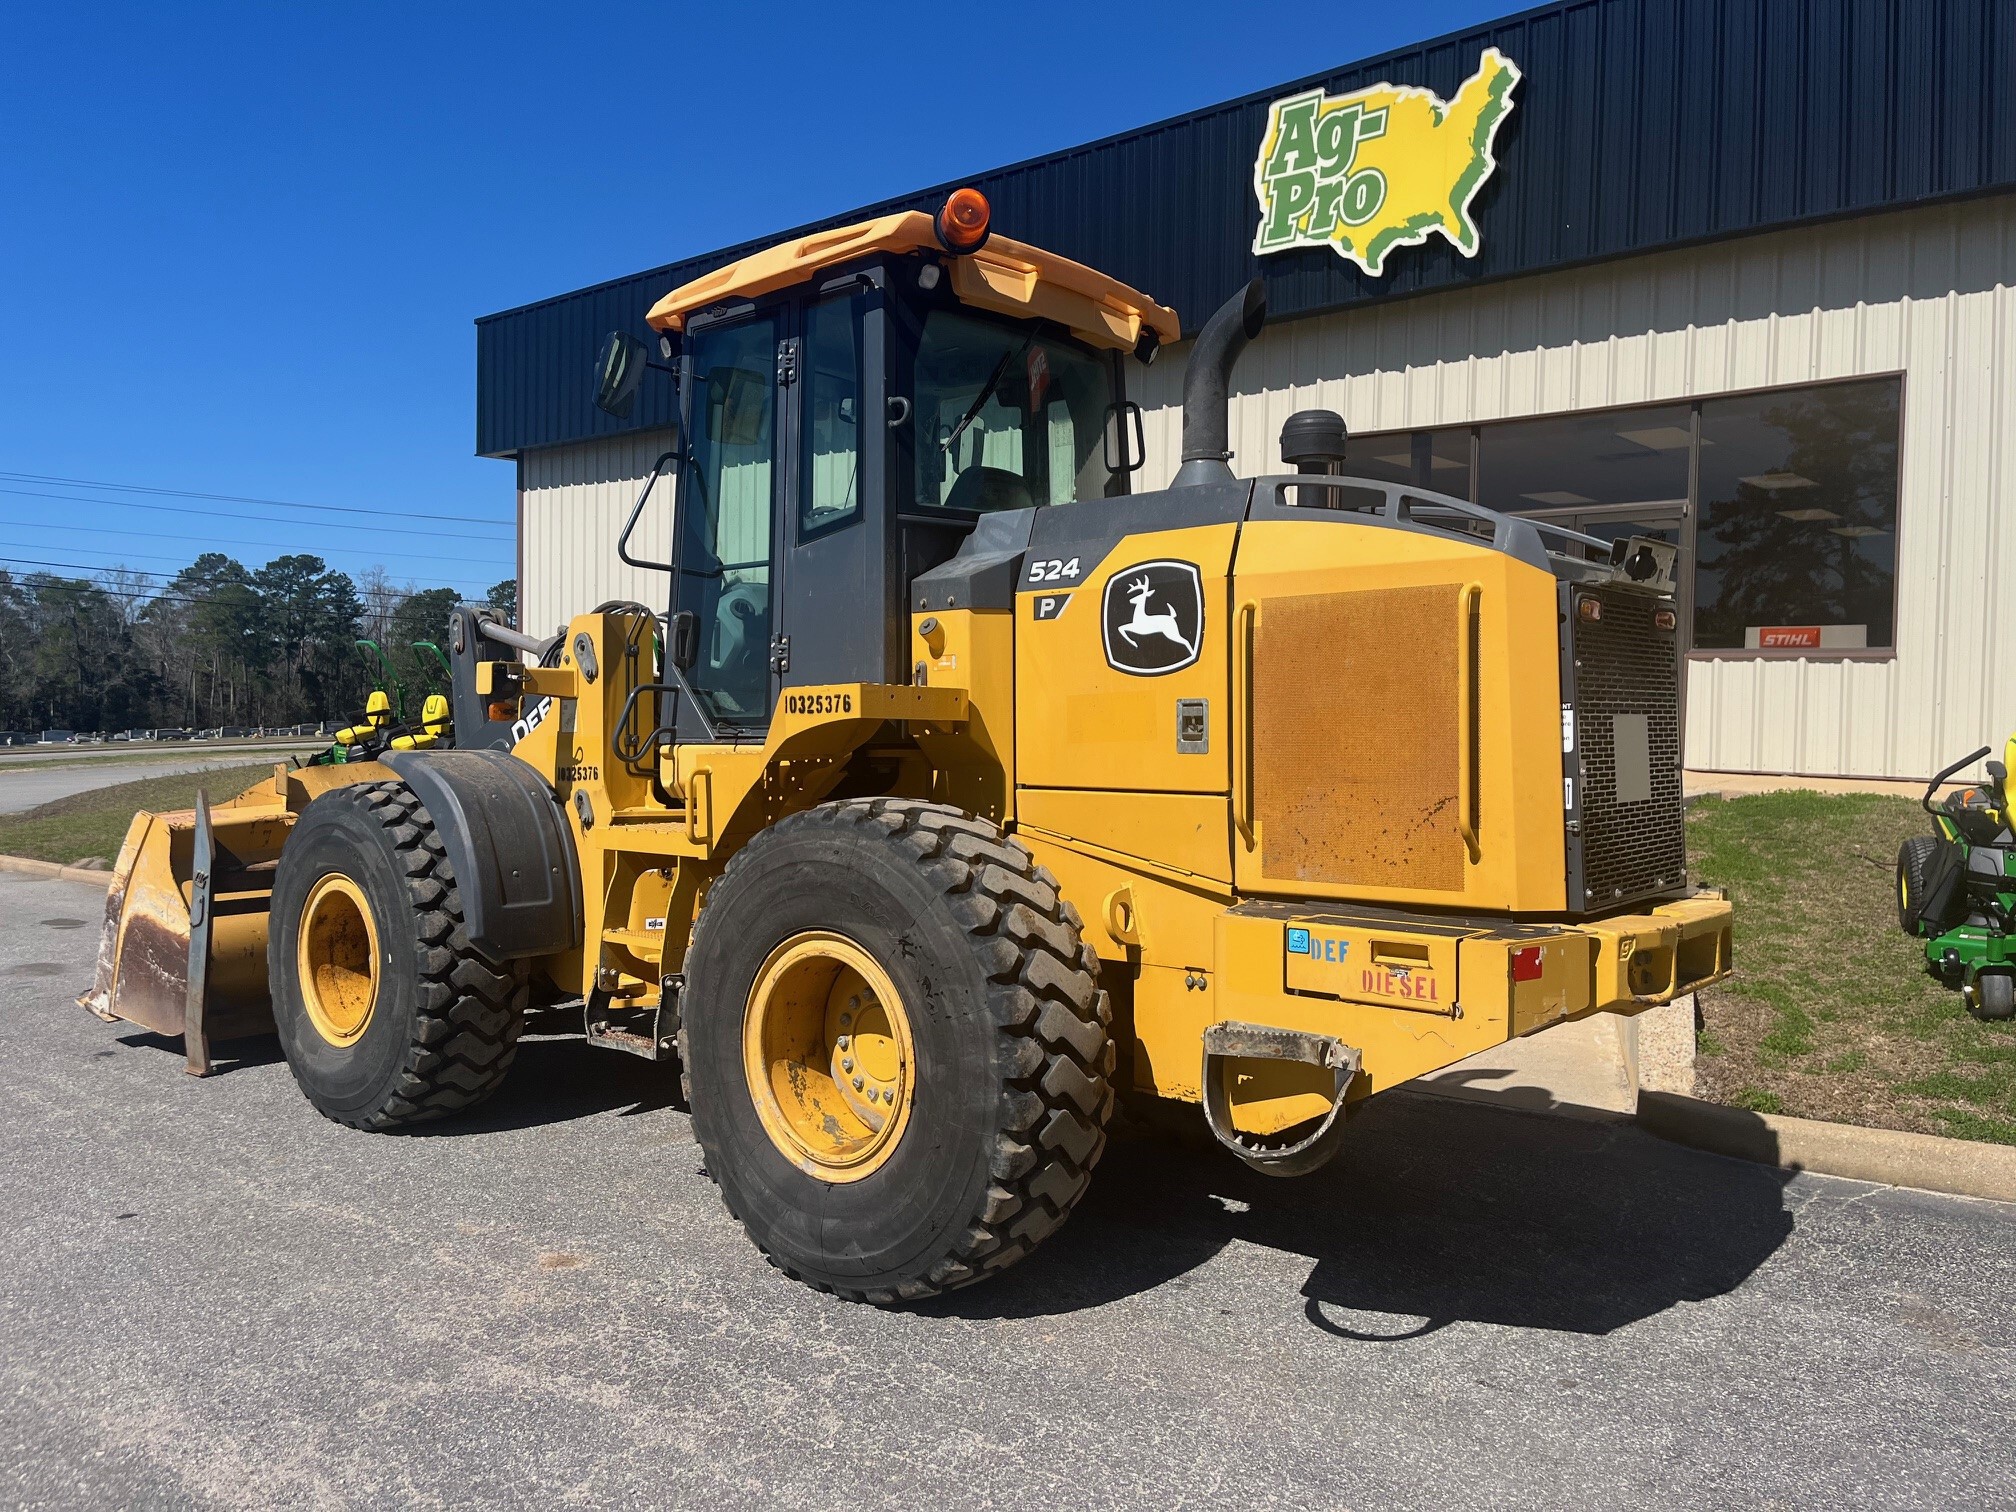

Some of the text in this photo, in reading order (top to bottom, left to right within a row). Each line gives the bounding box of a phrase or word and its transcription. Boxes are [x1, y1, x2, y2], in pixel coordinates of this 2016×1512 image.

[1264, 96, 1388, 182] Ag-
[1262, 168, 1386, 246] Pro
[1028, 556, 1080, 583] 524
[1039, 598, 1056, 618] P
[1763, 633, 1812, 646] STIHL
[784, 693, 851, 714] 10325376
[557, 766, 599, 782] 10325376
[1310, 938, 1350, 963] DEF
[1362, 970, 1439, 1000] DIESEL
